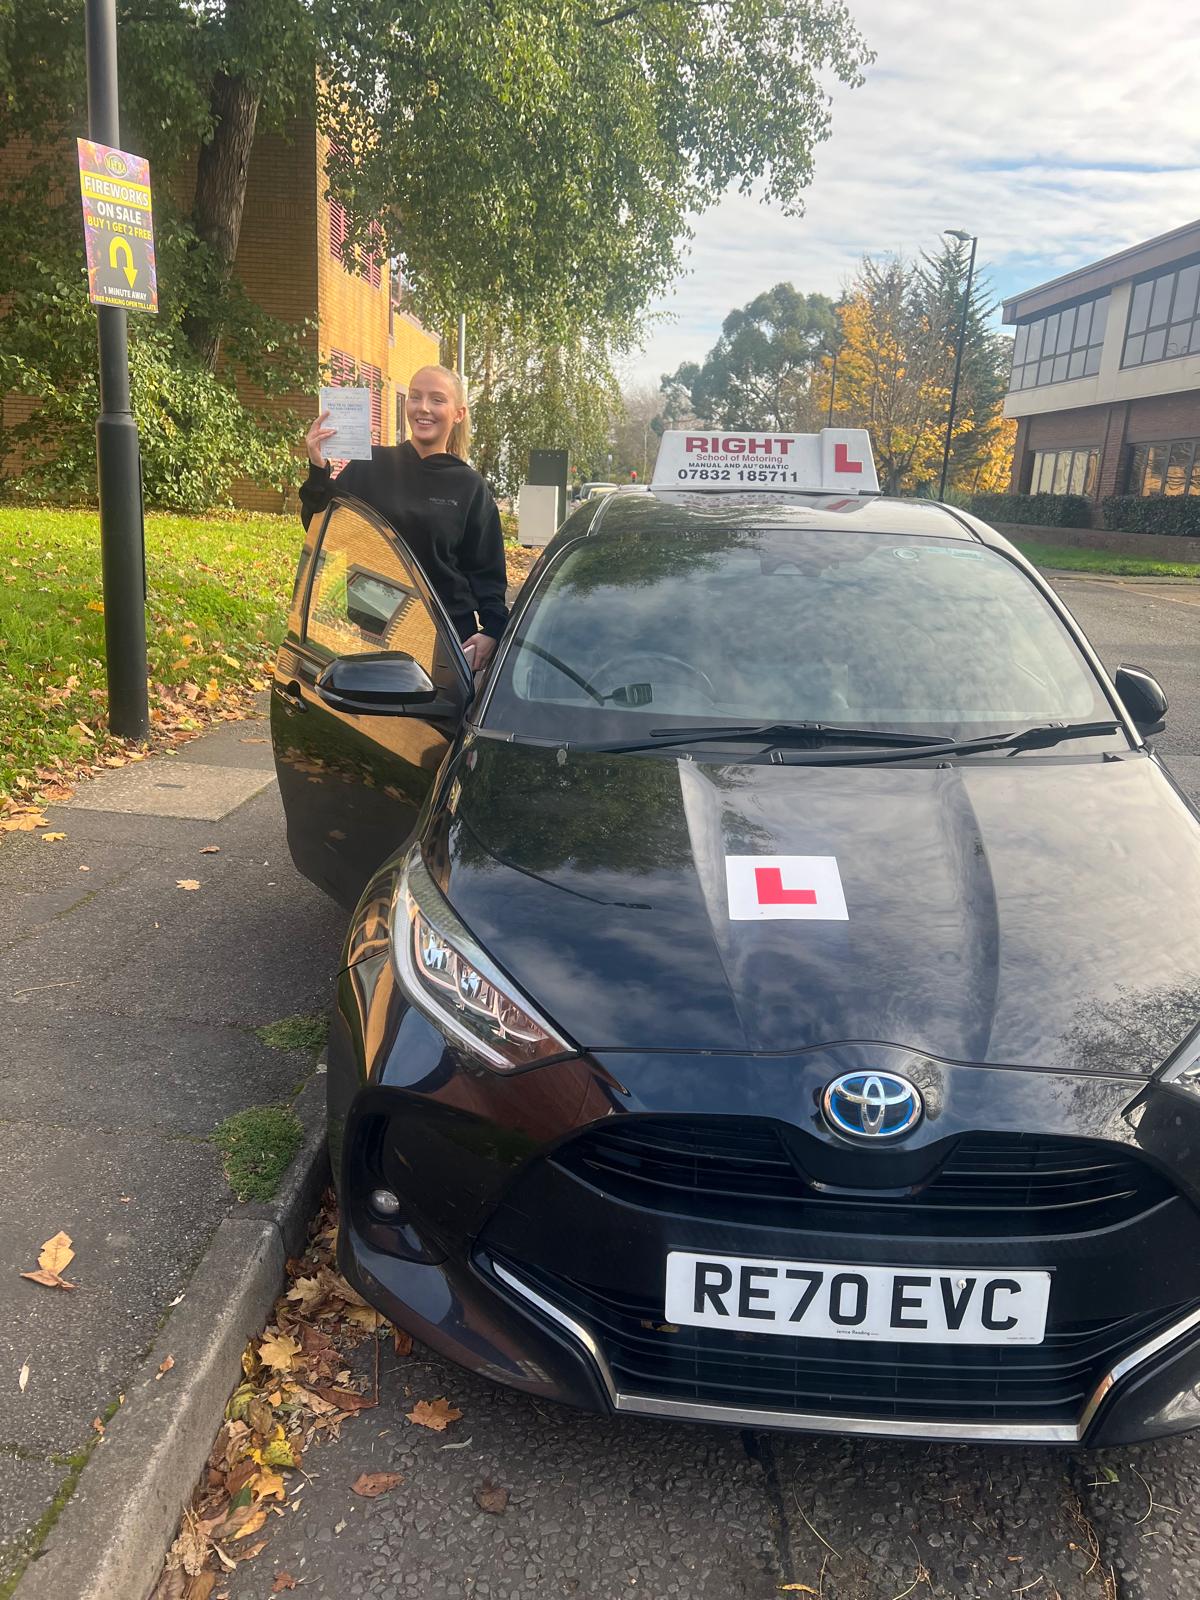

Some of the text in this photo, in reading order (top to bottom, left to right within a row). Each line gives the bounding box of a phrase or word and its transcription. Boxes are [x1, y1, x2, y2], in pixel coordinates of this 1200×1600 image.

[84, 175, 149, 207] FIREWORKS
[97, 201, 142, 225] ON SALE
[87, 215, 152, 241] BUY 1 GET 2 FREE
[105, 296, 126, 306] PARKING
[108, 286, 131, 298] MINUTE
[131, 290, 147, 300] AWAY
[685, 437, 795, 455] RIGHT
[835, 443, 863, 473] L
[696, 453, 783, 464] School of Motoring
[677, 469, 798, 482] 07832 185711
[754, 868, 817, 904] L
[693, 1261, 1022, 1331] RE70 EVC
